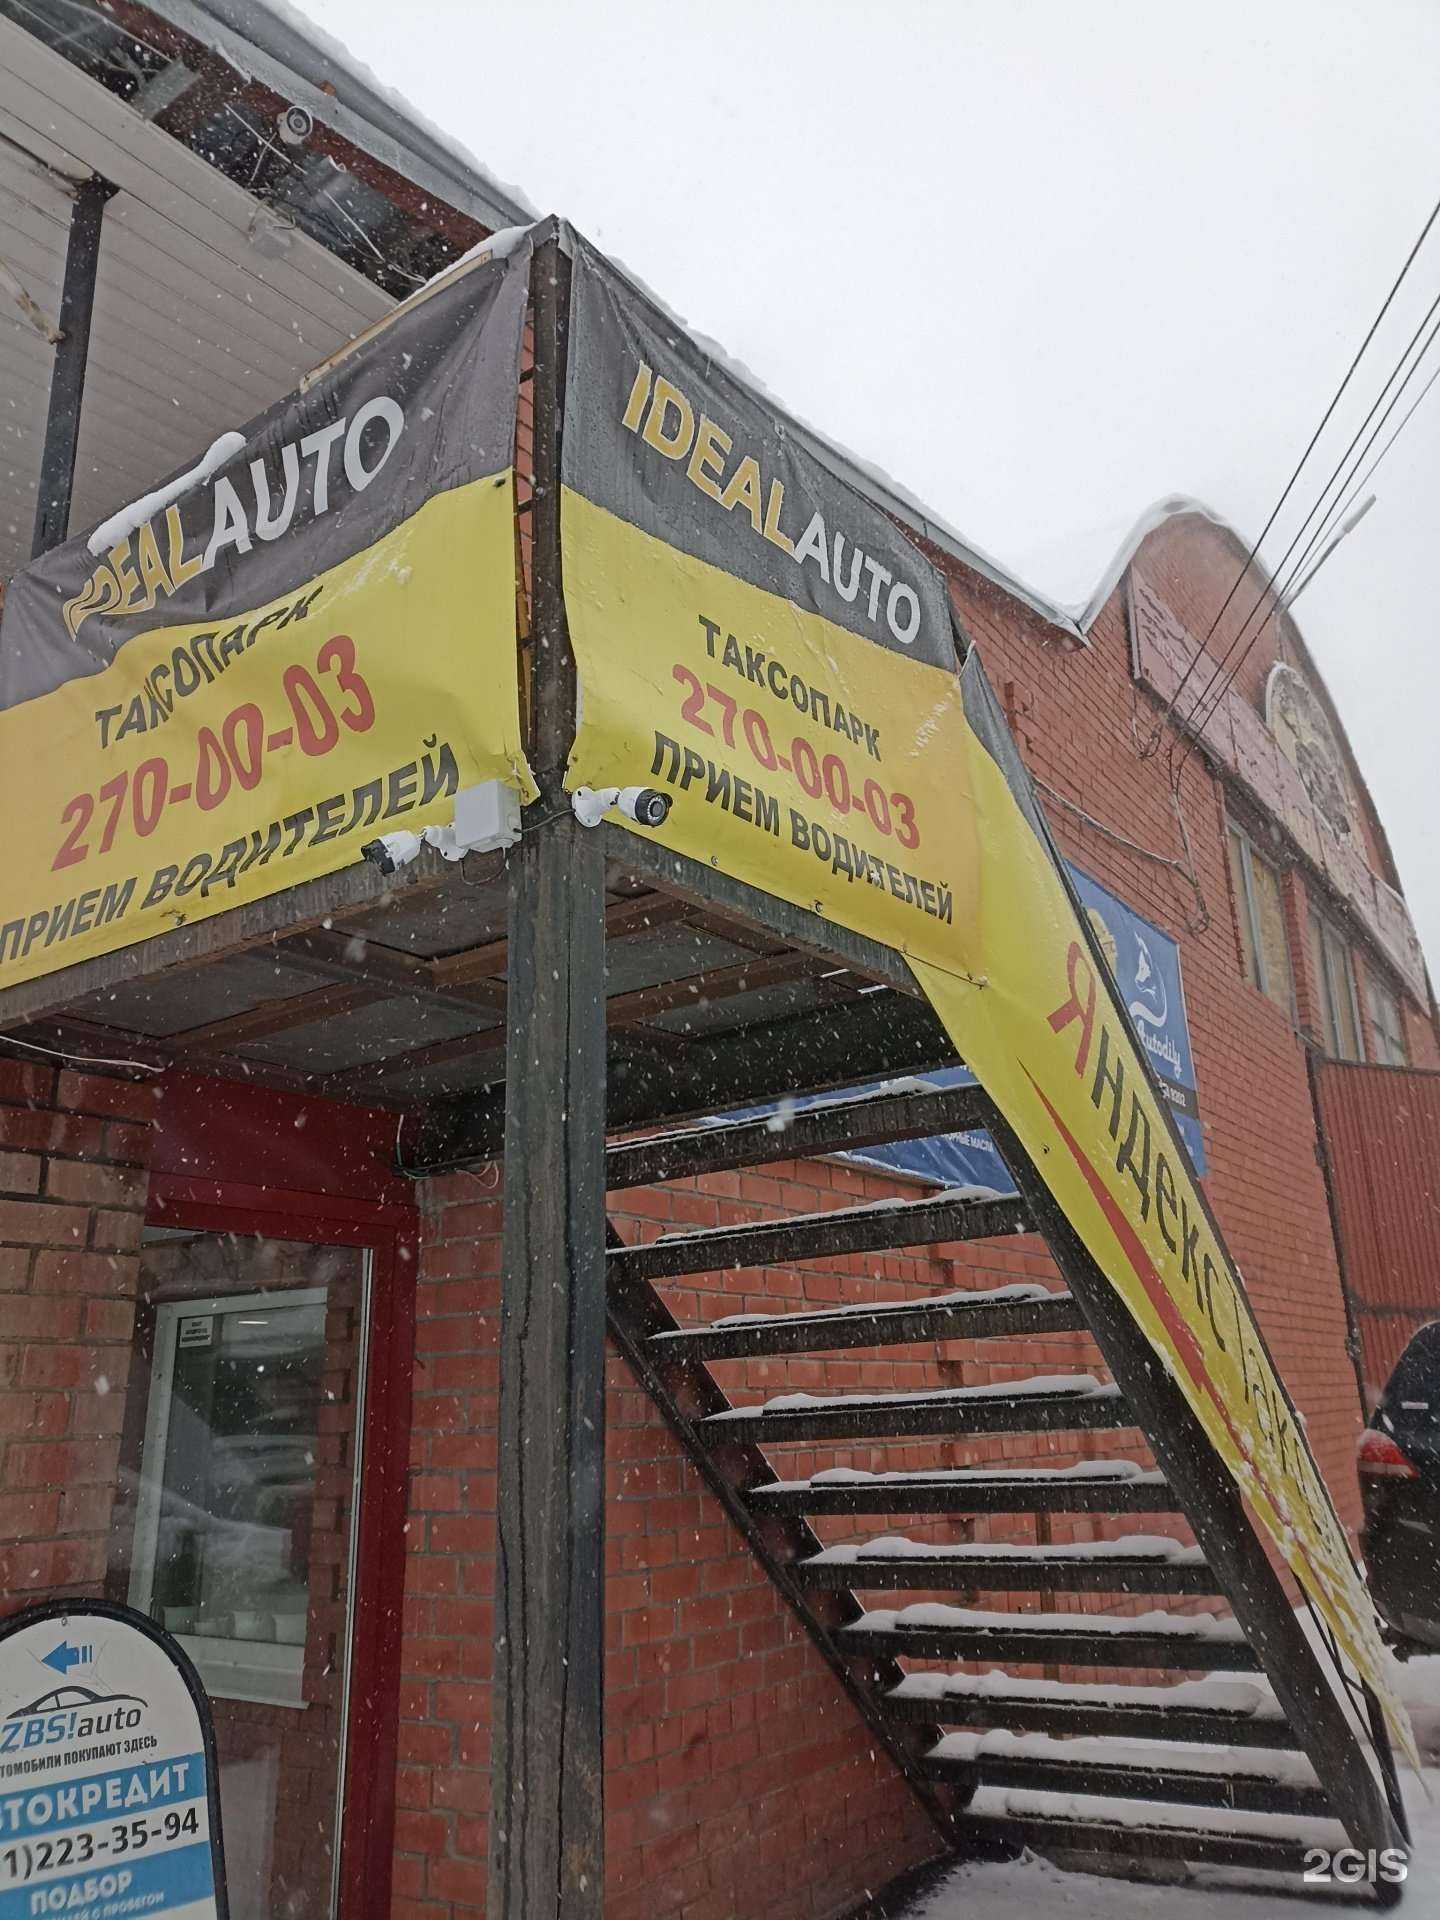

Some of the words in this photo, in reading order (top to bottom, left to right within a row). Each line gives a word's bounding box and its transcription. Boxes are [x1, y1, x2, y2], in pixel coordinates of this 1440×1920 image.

[51, 635, 375, 872] 270-00-03
[95, 586, 324, 750] ТАКСОПАРК
[699, 615, 882, 762] ТАКСОПАРК
[650, 731, 781, 838] ПРИЕМ
[790, 809, 954, 926] ВОДИТЕЛЕЙ
[672, 664, 921, 851] 270-00-03
[0, 877, 137, 966] ПРИЕМ
[140, 733, 460, 898] ВОДИТЕЛЕЙ
[64, 1742, 122, 1766] ПОКУПАЮТ
[124, 1735, 158, 1754] ЗДЕСЬ
[31, 1870, 133, 1916] ПОДБОР
